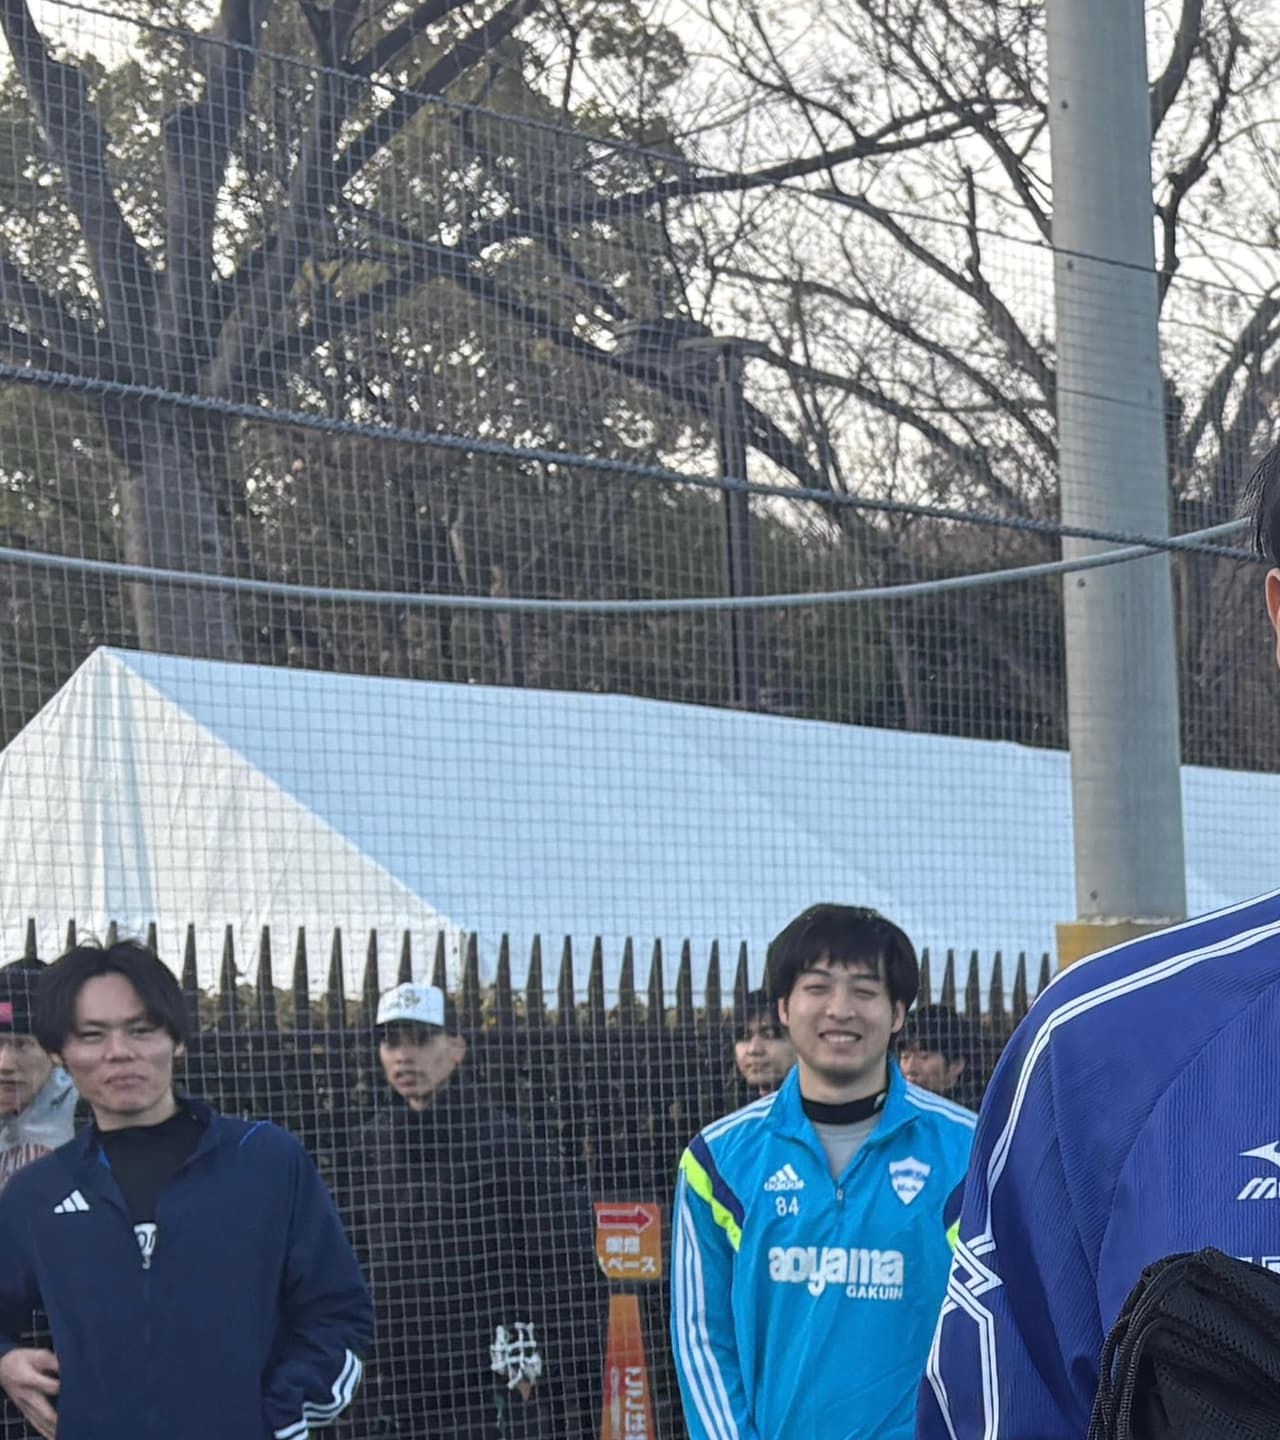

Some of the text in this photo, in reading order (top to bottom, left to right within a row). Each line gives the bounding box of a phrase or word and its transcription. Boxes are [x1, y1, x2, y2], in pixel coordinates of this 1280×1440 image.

[775, 1196, 799, 1216] 84
[768, 1246, 904, 1296] aoyama
[846, 1285, 903, 1300] GAKUIN
